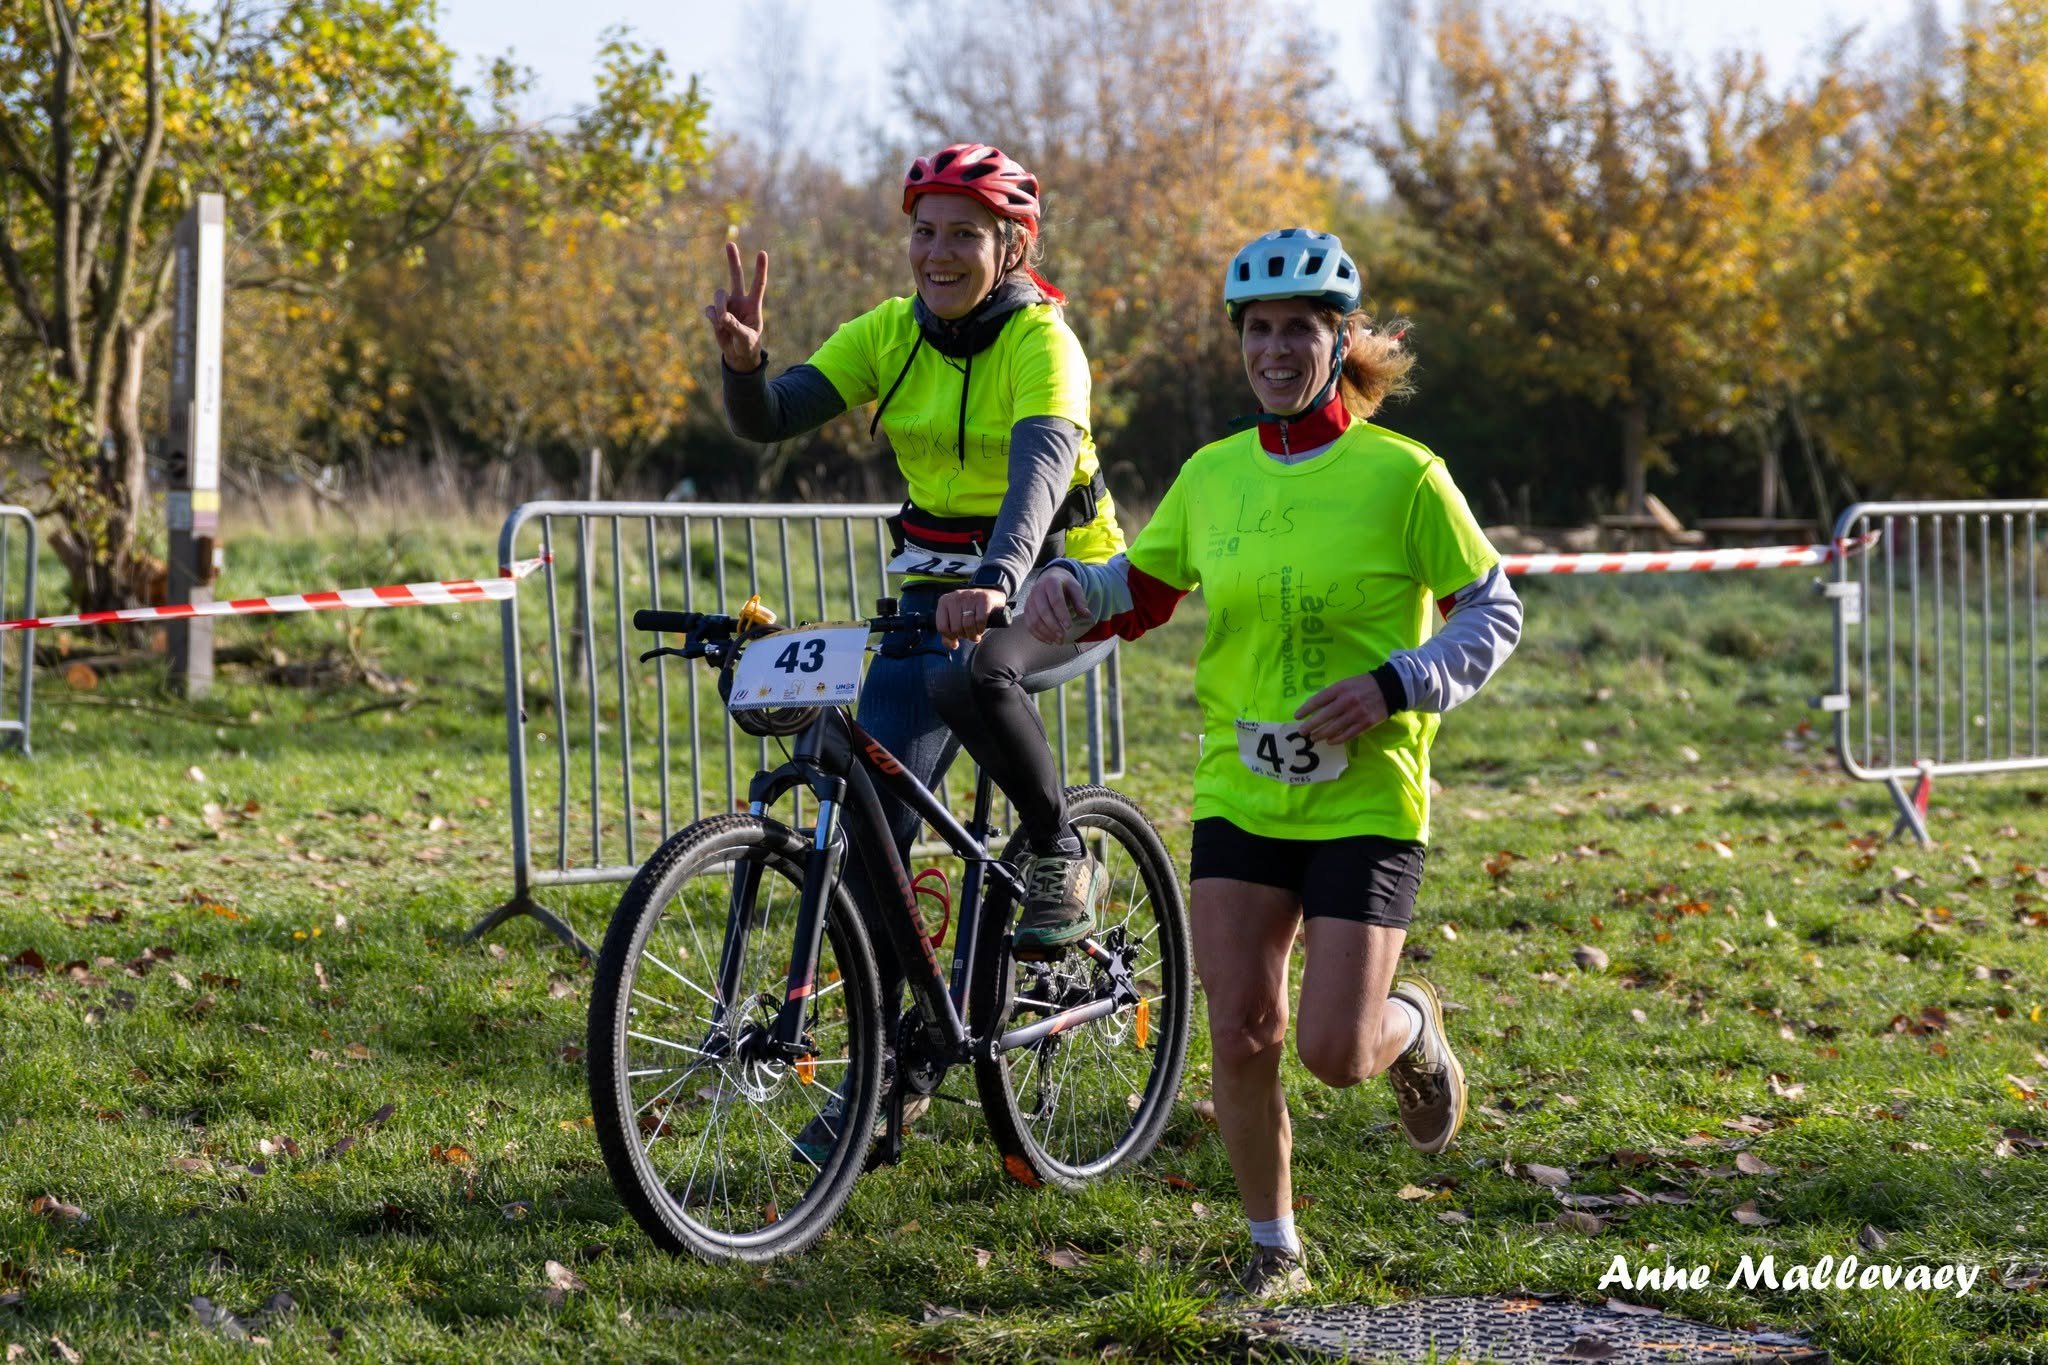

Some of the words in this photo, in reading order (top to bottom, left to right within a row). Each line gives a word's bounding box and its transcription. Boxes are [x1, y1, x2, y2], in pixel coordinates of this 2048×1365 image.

[1237, 493, 1294, 537] Les
[774, 638, 826, 674] 43
[1256, 731, 1320, 774] 43
